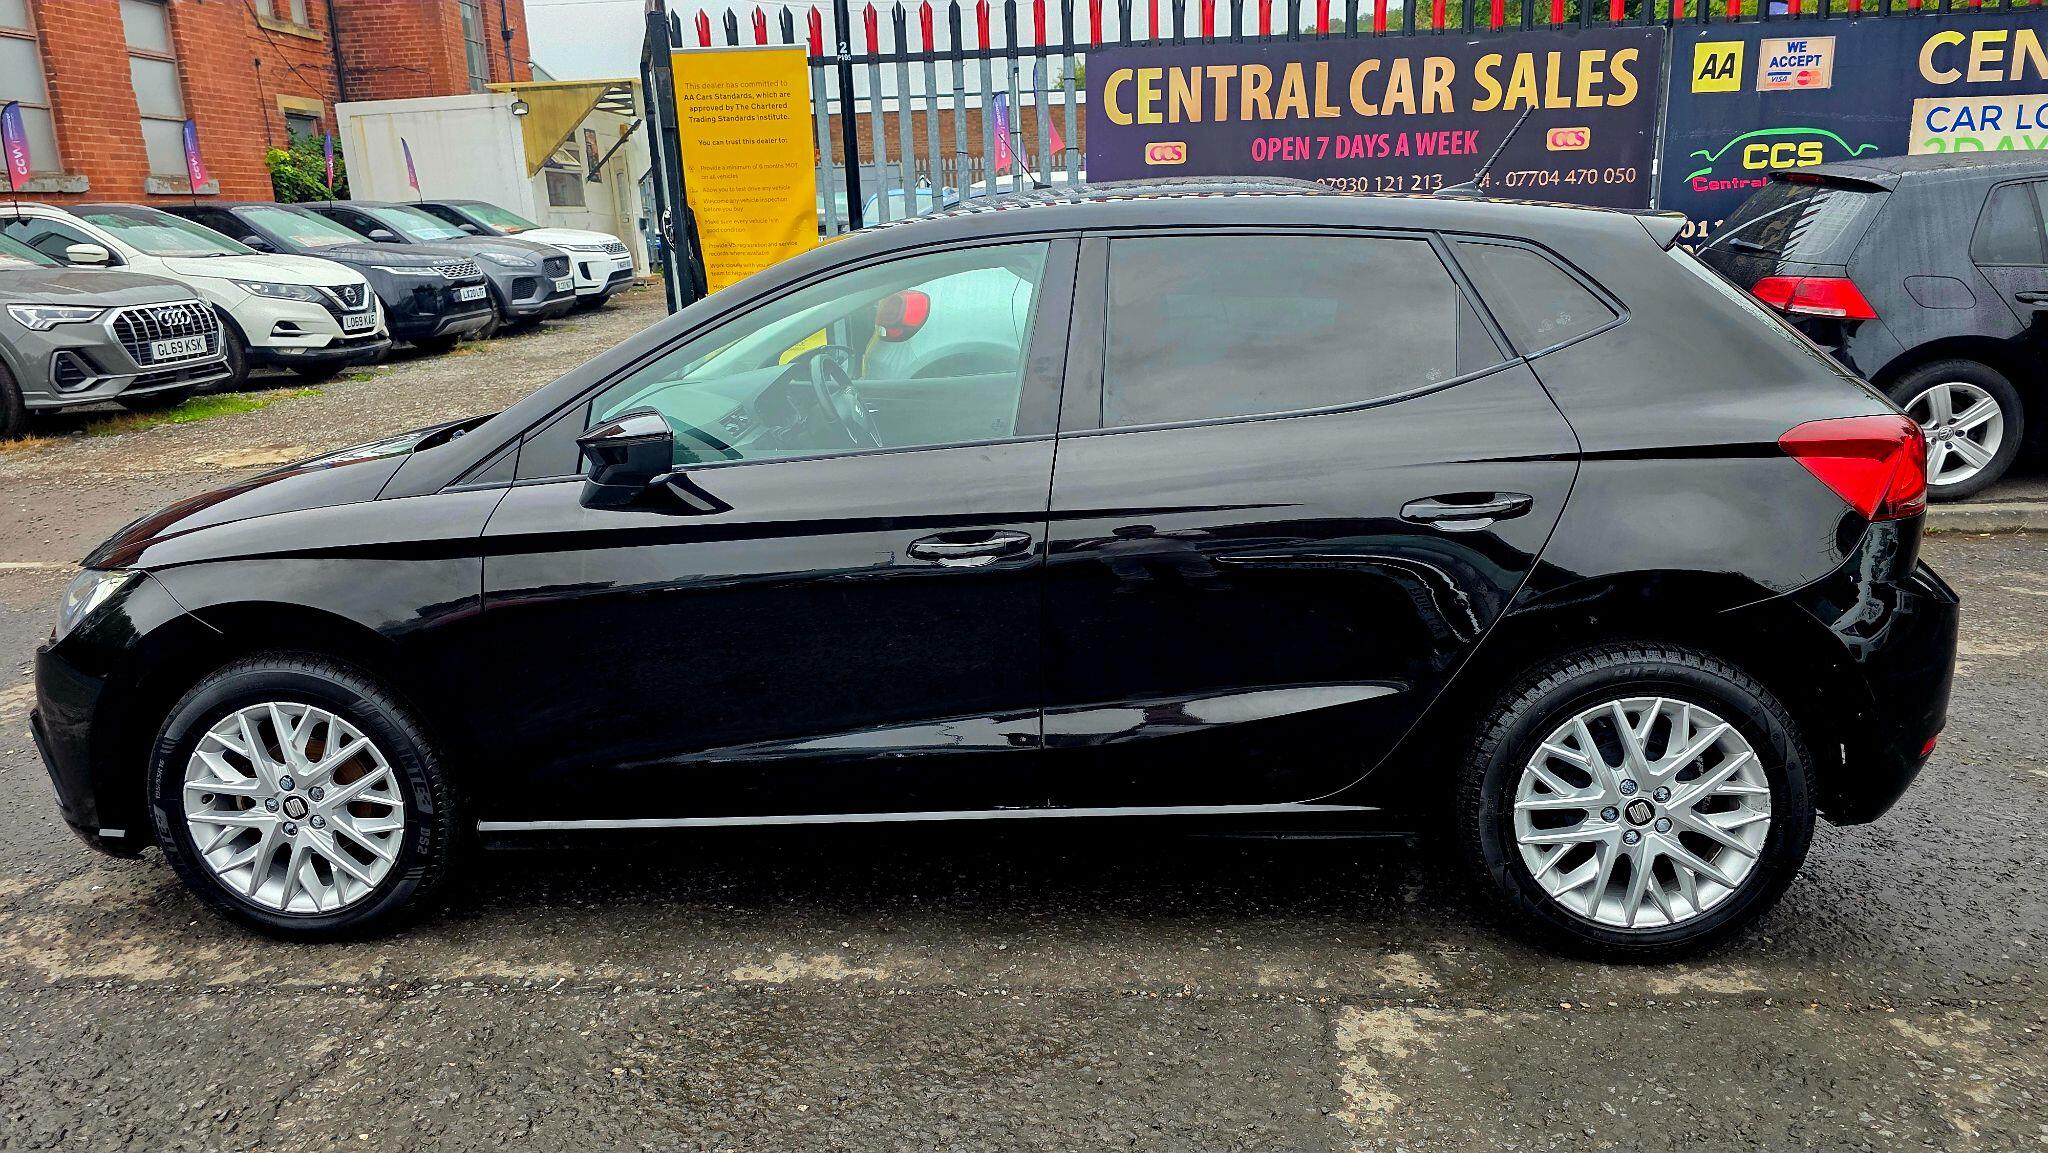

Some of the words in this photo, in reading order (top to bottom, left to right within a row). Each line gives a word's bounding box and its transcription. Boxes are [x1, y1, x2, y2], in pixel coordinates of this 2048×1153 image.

[839, 41, 848, 54] 2
[1787, 41, 1808, 53] WE
[1698, 52, 1736, 80] AA
[1770, 54, 1822, 68] ACCEPT
[740, 80, 778, 88] committed
[1103, 61, 1341, 126] CENTRAL
[1350, 56, 1456, 117] CAR
[1472, 48, 1640, 112] SALES
[690, 104, 724, 112] approved
[726, 104, 734, 112] by
[750, 102, 788, 110] Chartered
[1926, 105, 2003, 132] CAR
[1252, 136, 1310, 162] OPEN
[1316, 136, 1330, 160] 7
[1336, 132, 1390, 158] DAYS
[1396, 132, 1410, 157] A
[1416, 130, 1480, 156] WEEK
[1742, 142, 1824, 170] CCS
[1374, 176, 1402, 192] 121
[1411, 174, 1443, 191] 213
[1505, 170, 1560, 188] 07704
[1564, 169, 1598, 186] 470
[1604, 168, 1636, 184] 050
[1692, 176, 1768, 192] Central
[364, 314, 376, 326] KAE
[158, 342, 184, 357] GL69
[185, 339, 204, 354] KSK
